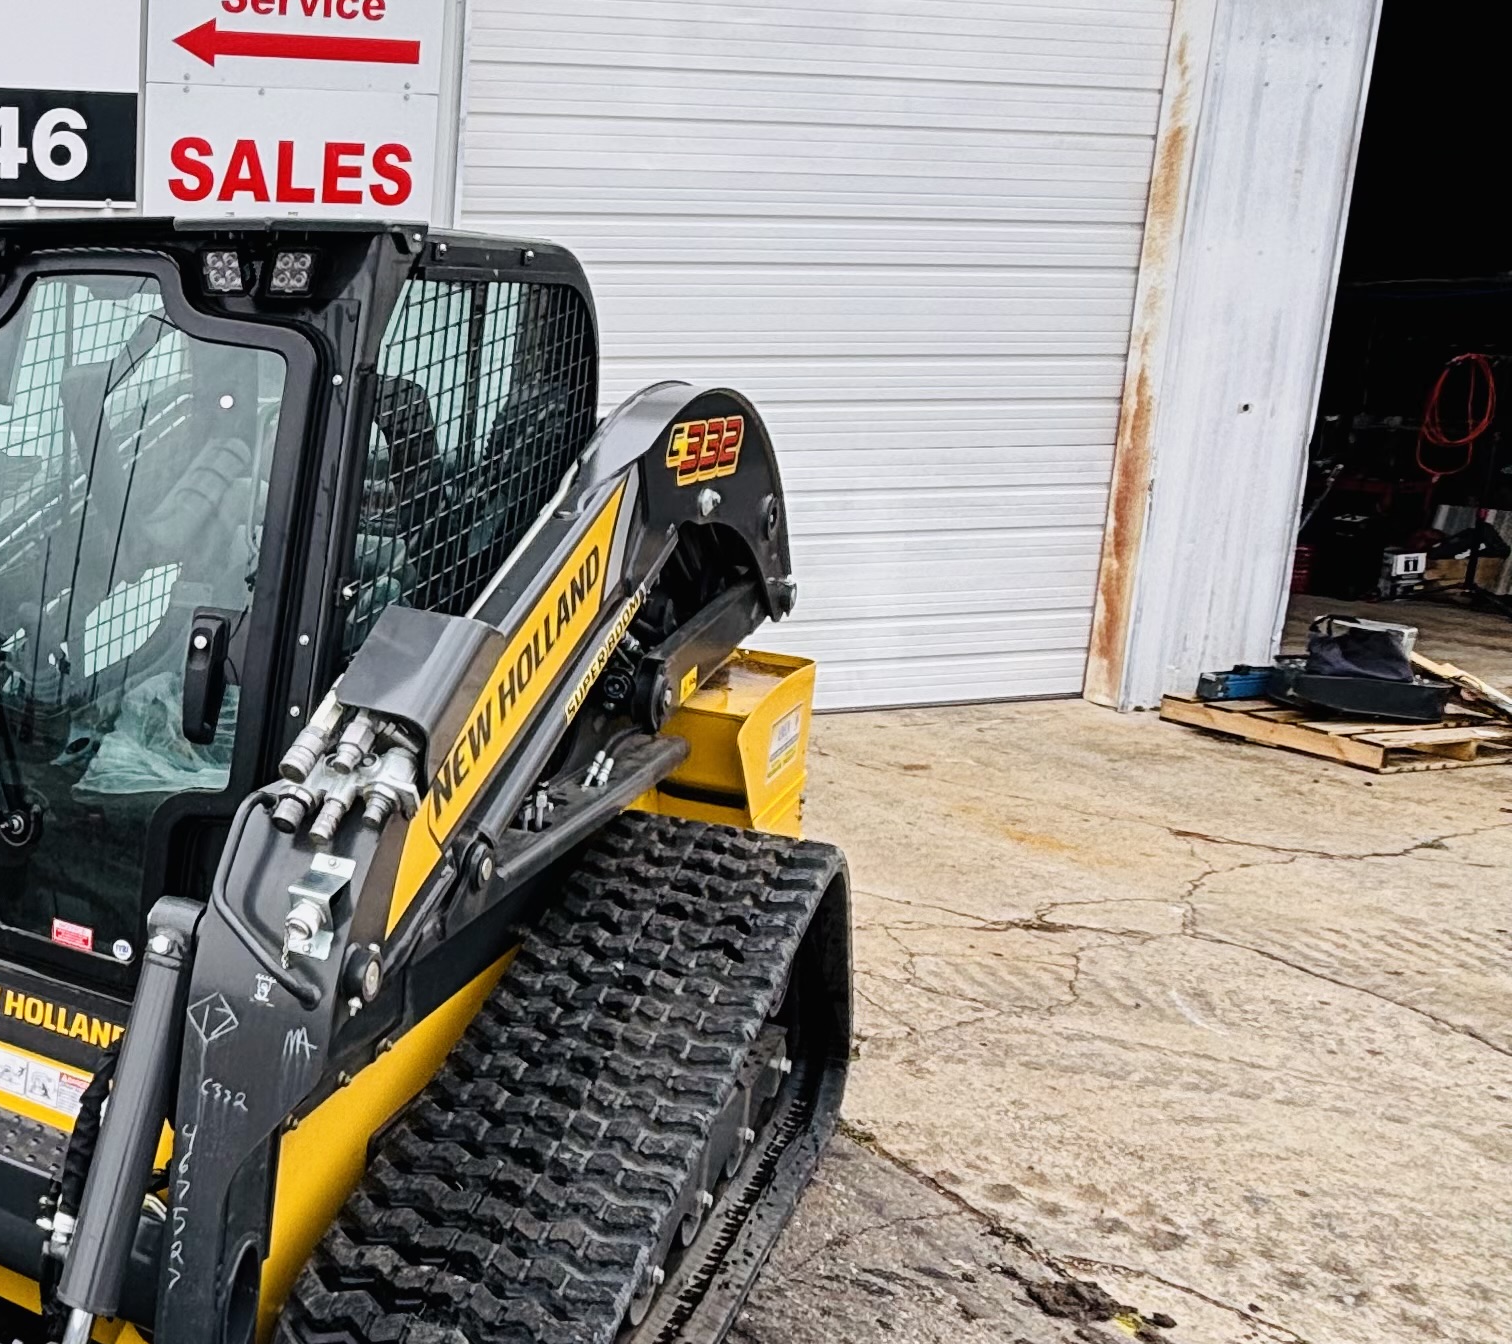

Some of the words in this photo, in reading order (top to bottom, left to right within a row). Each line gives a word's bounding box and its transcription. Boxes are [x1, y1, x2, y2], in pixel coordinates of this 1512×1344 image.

[168, 136, 413, 206] SALES
[431, 698, 491, 823] NEW
[497, 544, 601, 726] HOLLAND
[567, 651, 606, 717] SUPER
